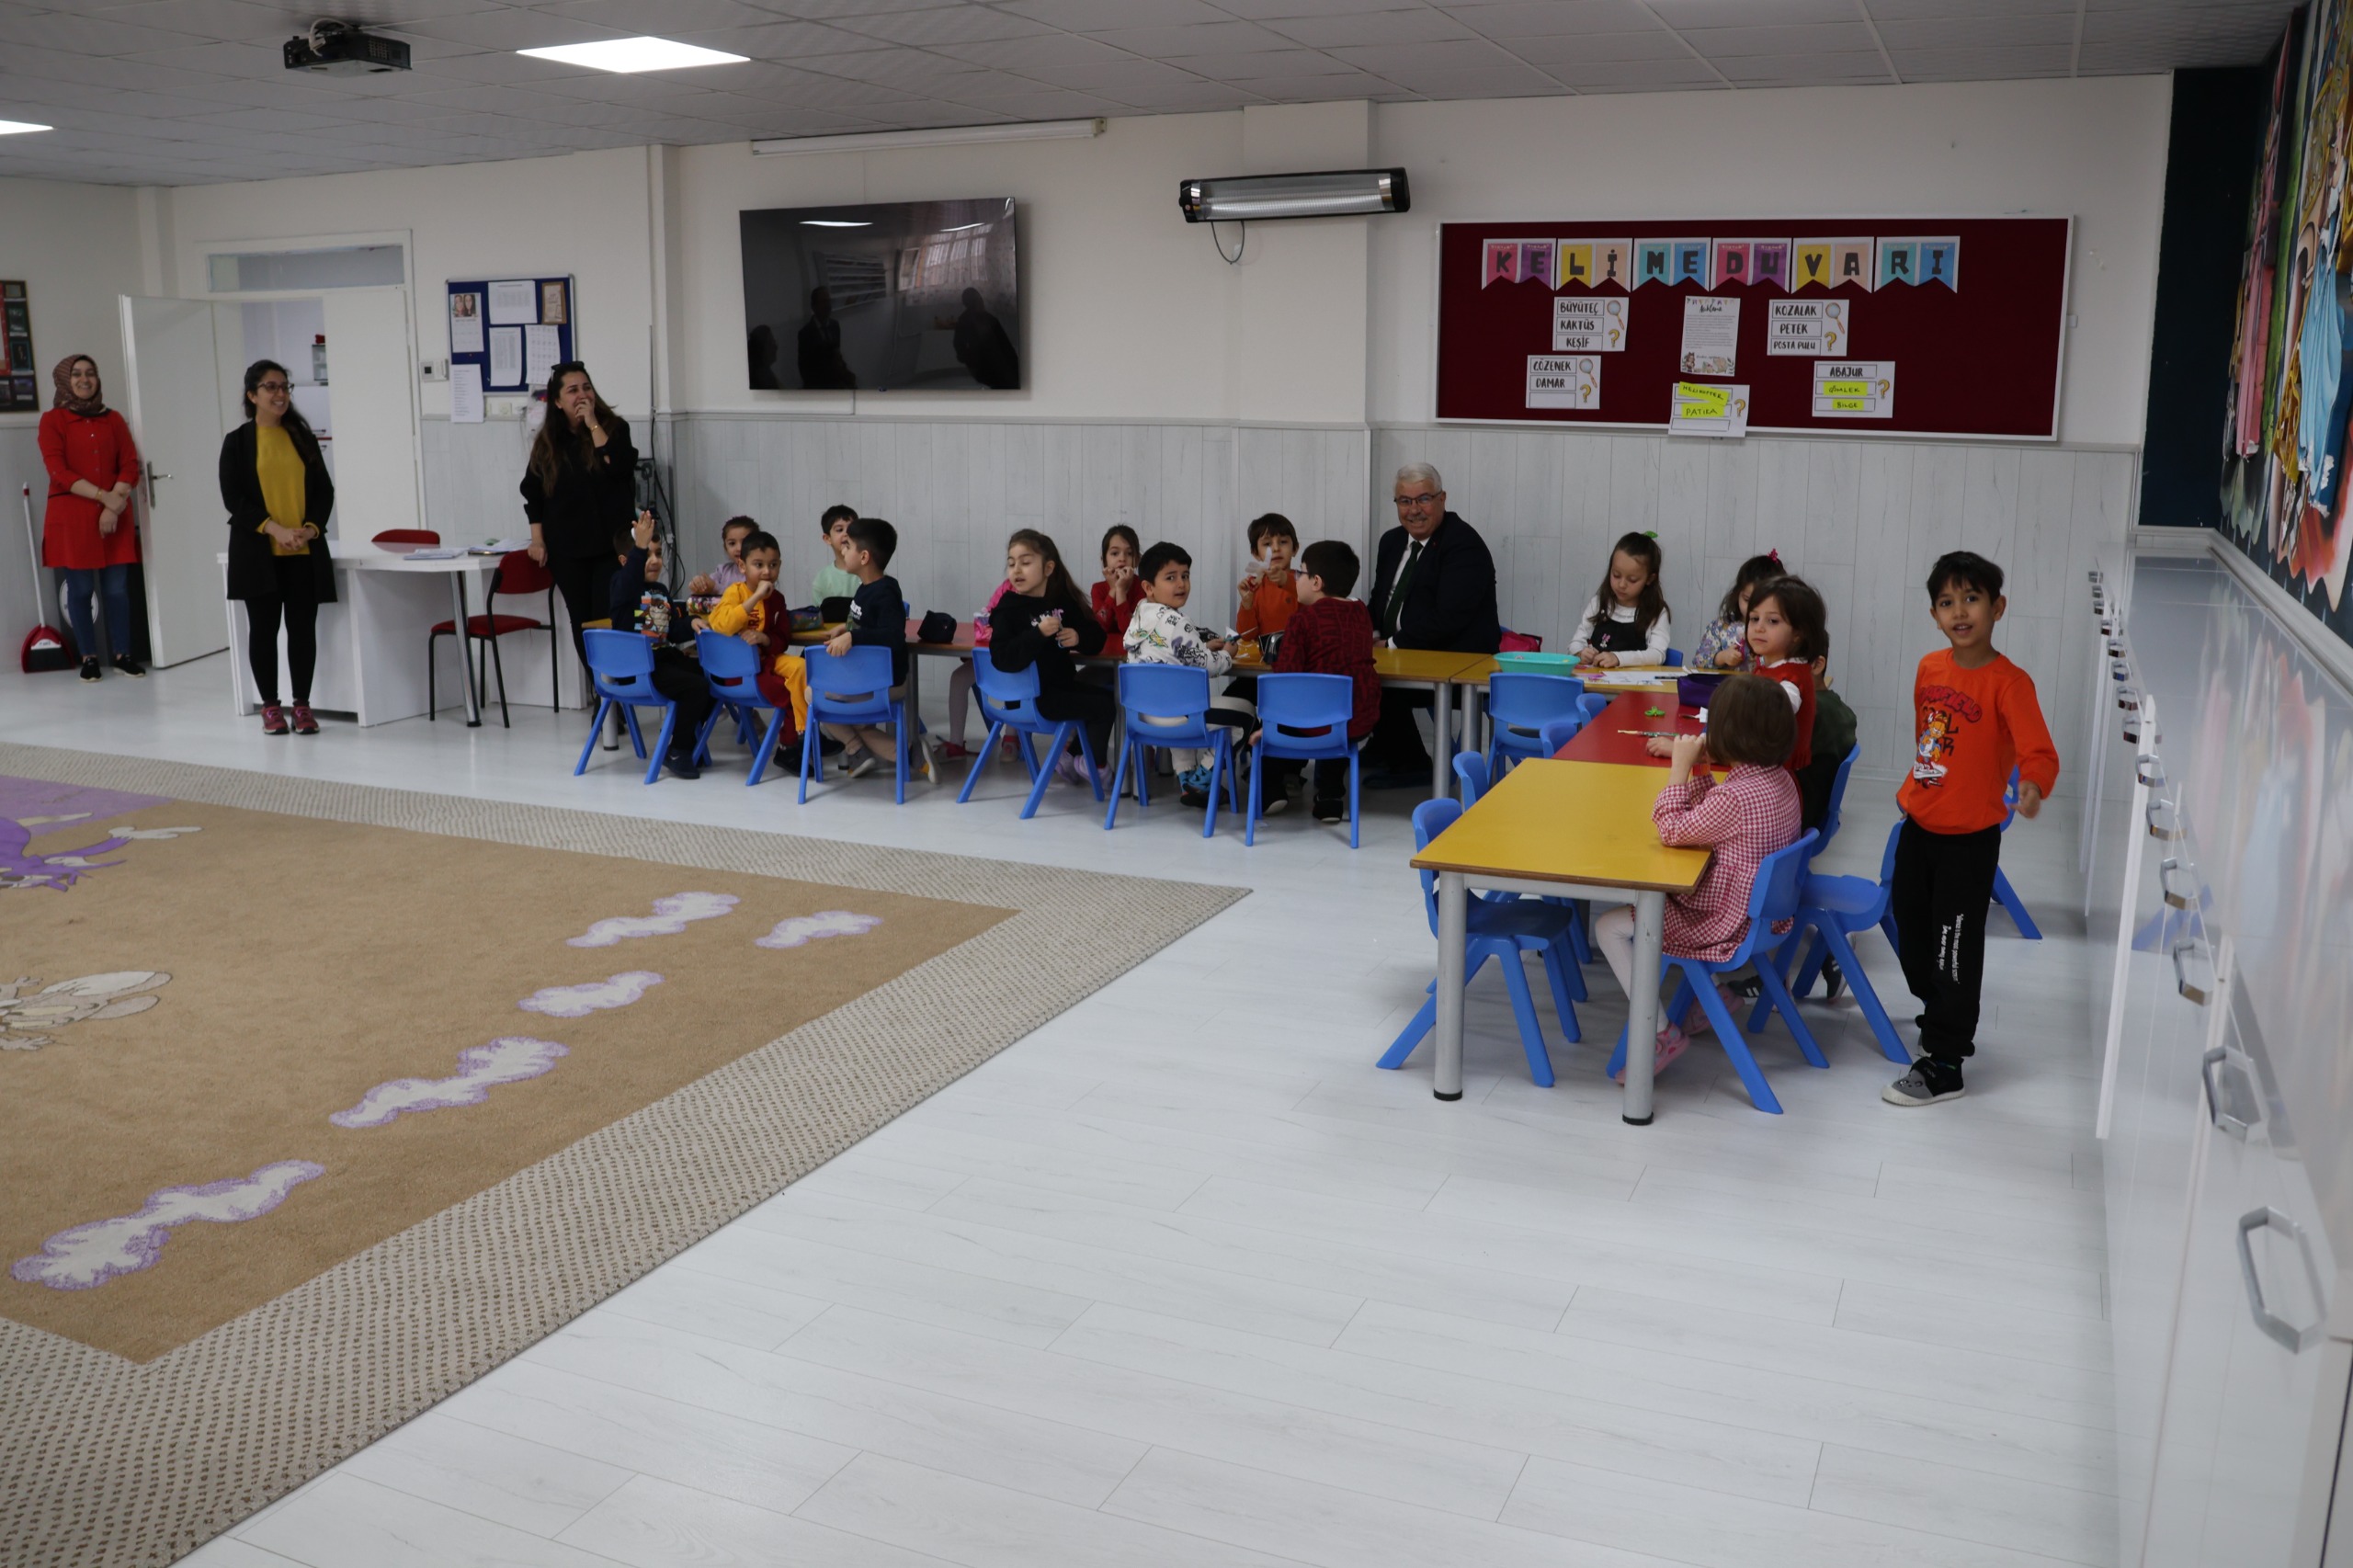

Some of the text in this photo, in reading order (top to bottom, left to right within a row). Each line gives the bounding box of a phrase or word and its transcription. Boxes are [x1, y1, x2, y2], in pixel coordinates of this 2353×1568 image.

[1495, 249, 1944, 277] KELİME DUVARI
[1560, 301, 1599, 315] BÜYÜTEÇ
[1775, 305, 1817, 316] KOZALAK
[1560, 319, 1595, 331] KAKTÜS
[1779, 323, 1808, 335] PETEK
[1566, 335, 1590, 350] KEŞİF
[1773, 341, 1816, 349] POSTA PULU
[1829, 367, 1864, 378] ABAJUR
[1536, 378, 1565, 388] DAMAR
